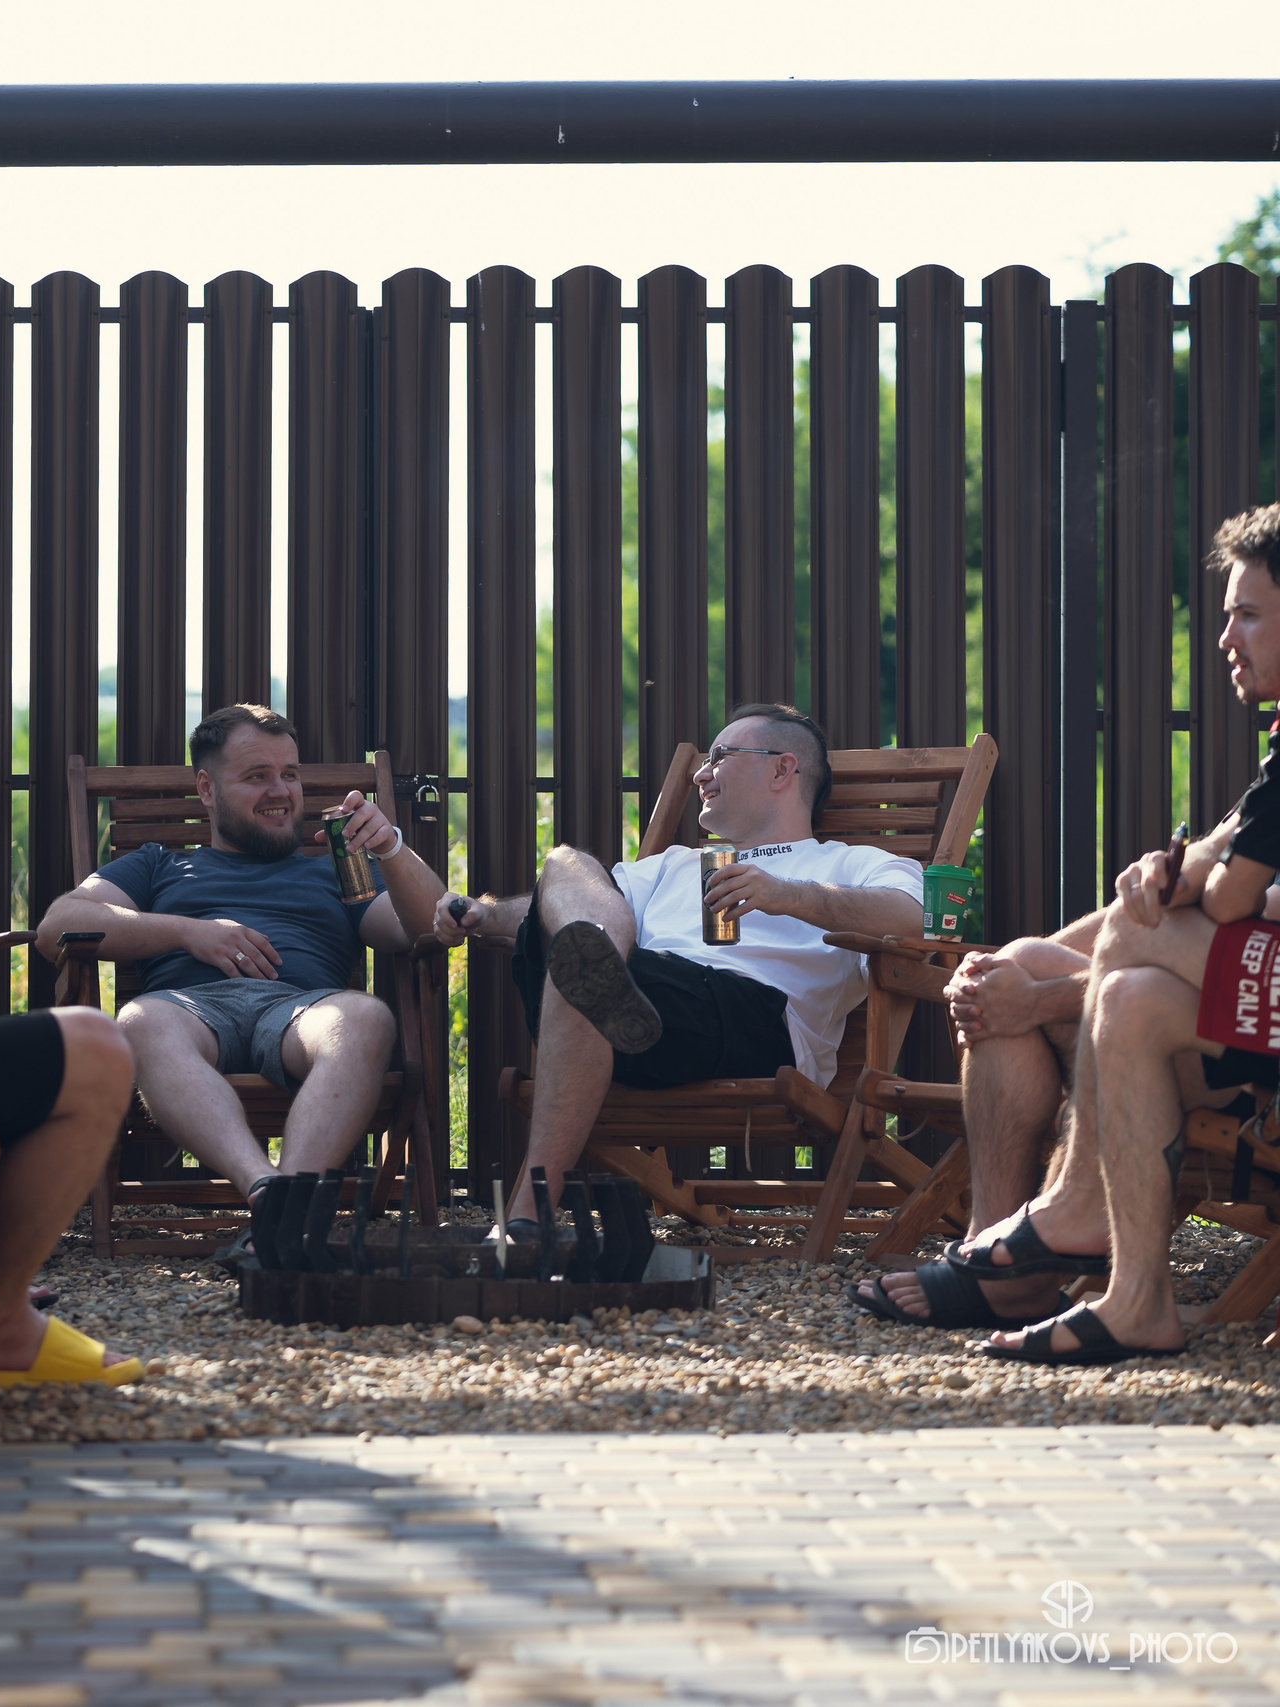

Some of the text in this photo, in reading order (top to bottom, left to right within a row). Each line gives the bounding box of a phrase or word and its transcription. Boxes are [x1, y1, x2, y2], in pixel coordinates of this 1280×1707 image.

[751, 844, 793, 858] Angeles
[1240, 929, 1273, 975] KEEP
[1235, 978, 1260, 1035] CALM
